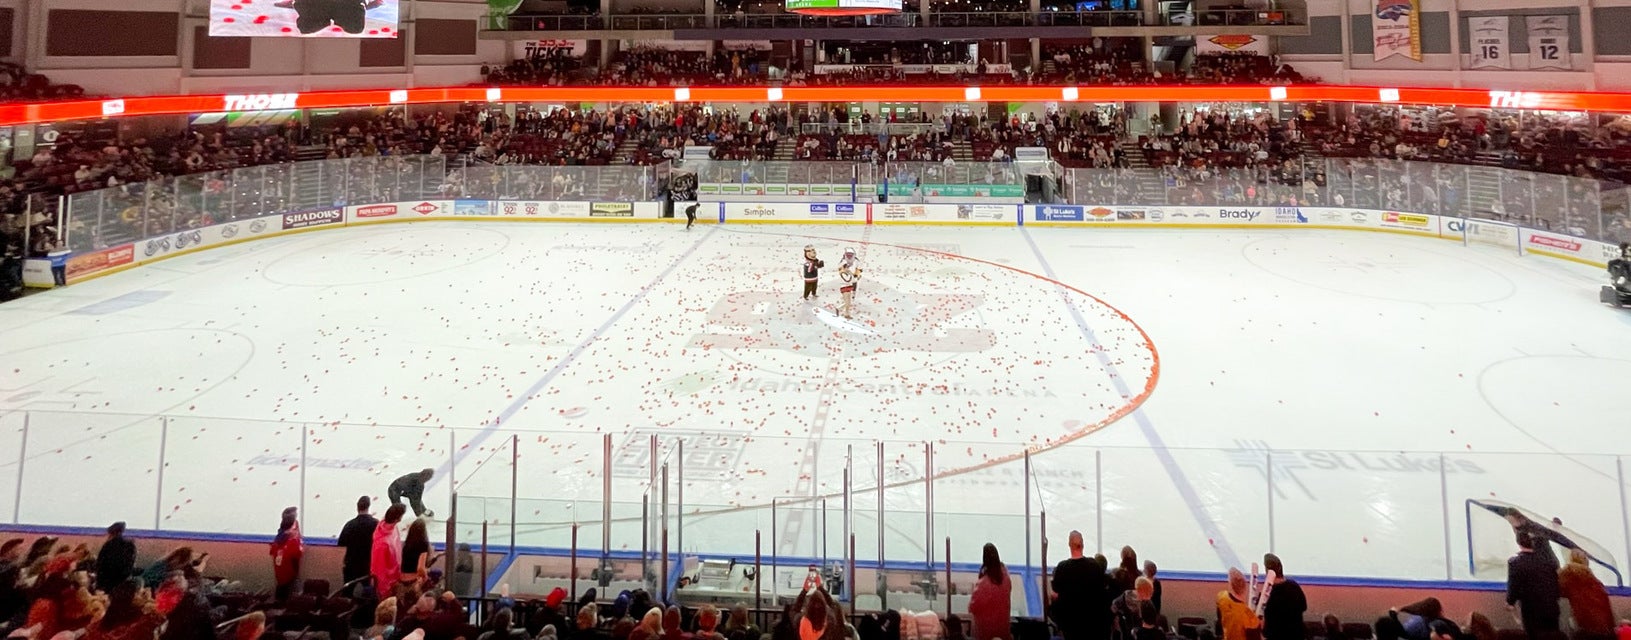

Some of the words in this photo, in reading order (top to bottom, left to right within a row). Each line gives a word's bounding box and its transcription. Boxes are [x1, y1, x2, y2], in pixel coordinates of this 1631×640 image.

[1482, 45, 1499, 59] 16
[1540, 45, 1558, 59] 12
[286, 209, 340, 224] SHADOWS
[744, 208, 775, 217] Simplot
[1219, 209, 1256, 221] Brady
[729, 377, 821, 393] Idaho
[1303, 451, 1356, 470] St
